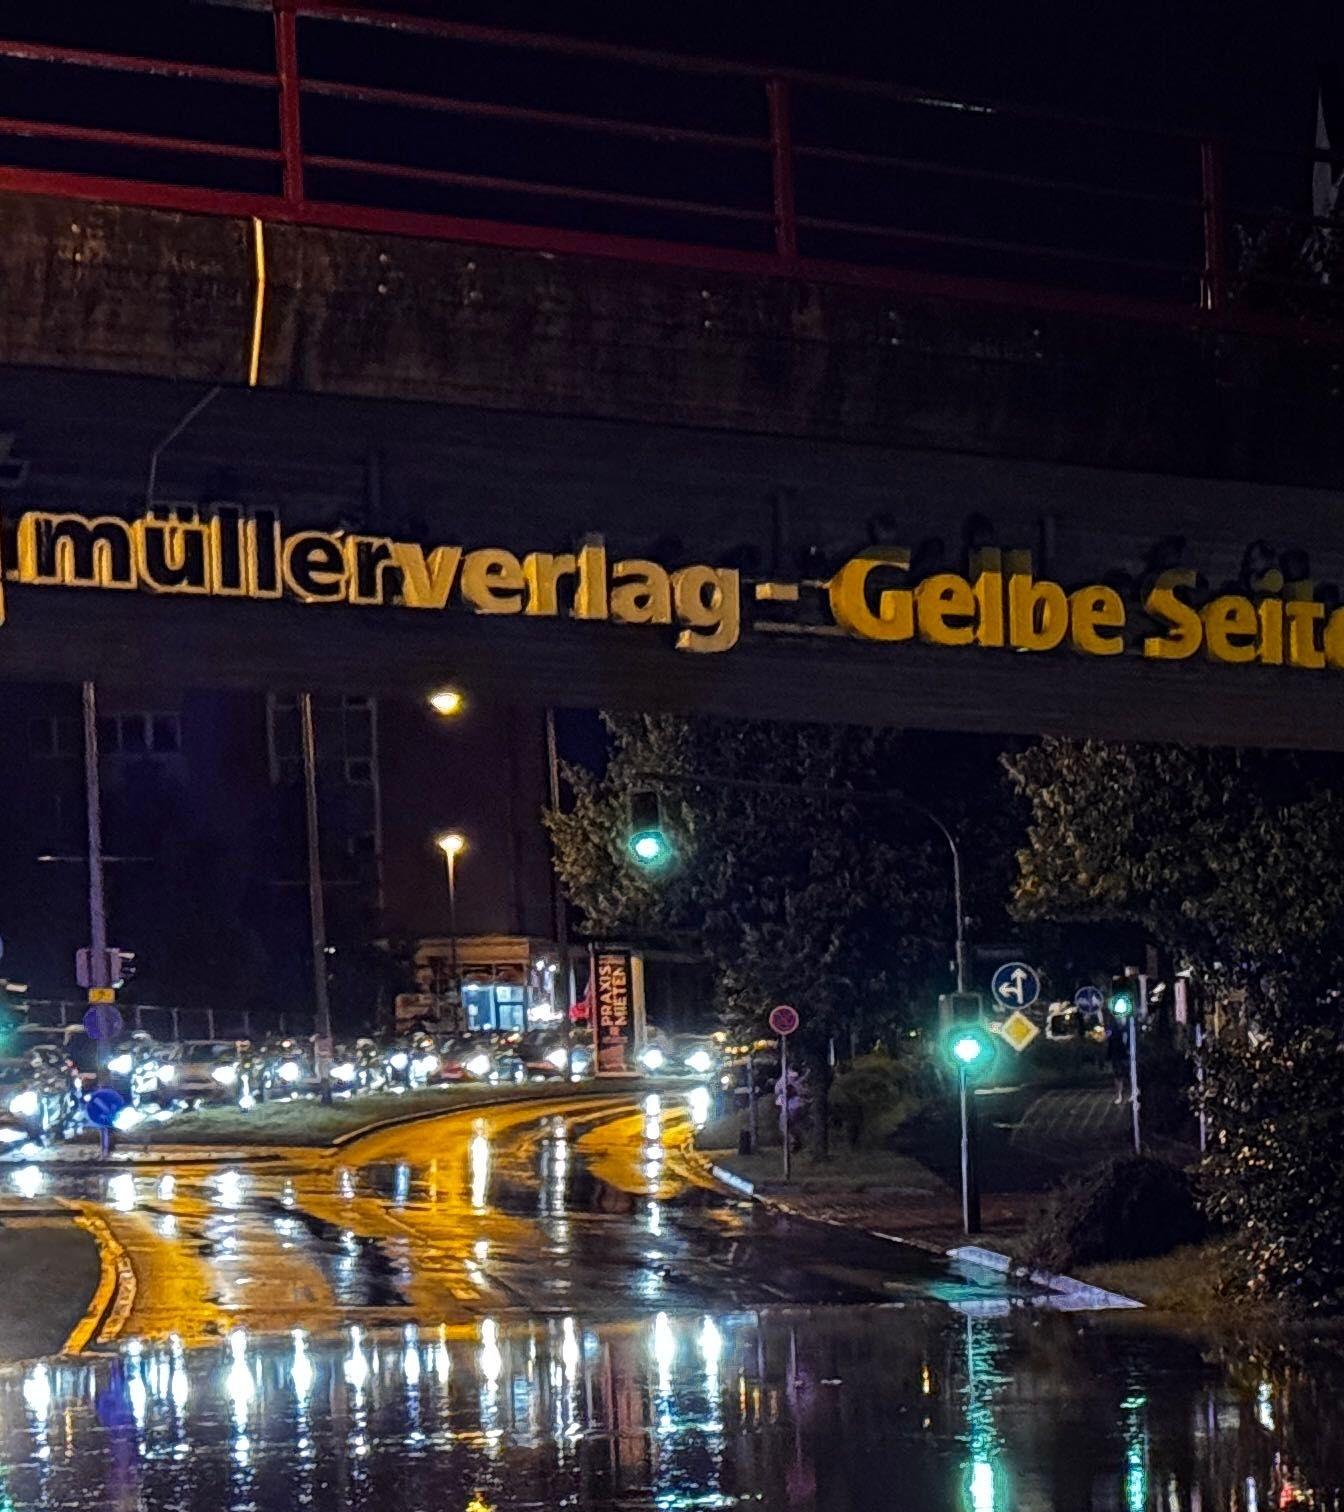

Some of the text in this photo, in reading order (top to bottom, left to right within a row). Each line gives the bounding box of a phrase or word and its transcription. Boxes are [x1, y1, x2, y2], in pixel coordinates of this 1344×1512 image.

[17, 503, 742, 653] müllerverlag
[829, 548, 1127, 656] Gelbe
[599, 965, 613, 1026] PRAXIS
[612, 967, 628, 1026] MIETEN
